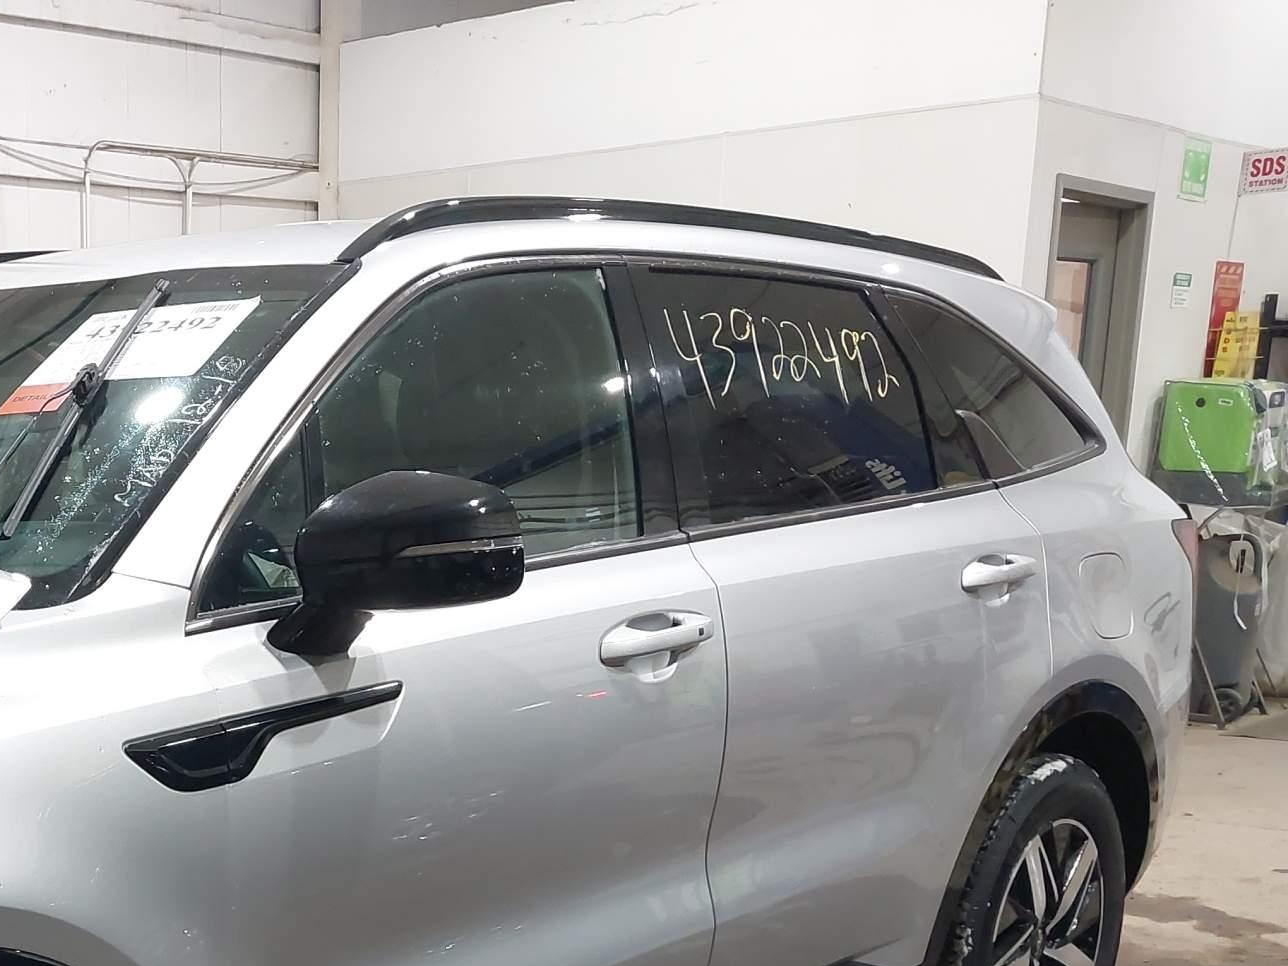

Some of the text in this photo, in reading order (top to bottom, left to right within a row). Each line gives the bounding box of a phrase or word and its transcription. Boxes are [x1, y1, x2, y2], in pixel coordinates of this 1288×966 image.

[1250, 156, 1286, 177] SDS
[1248, 178, 1284, 188] STATION
[86, 316, 222, 340] 4322492
[664, 307, 900, 410] 43922492
